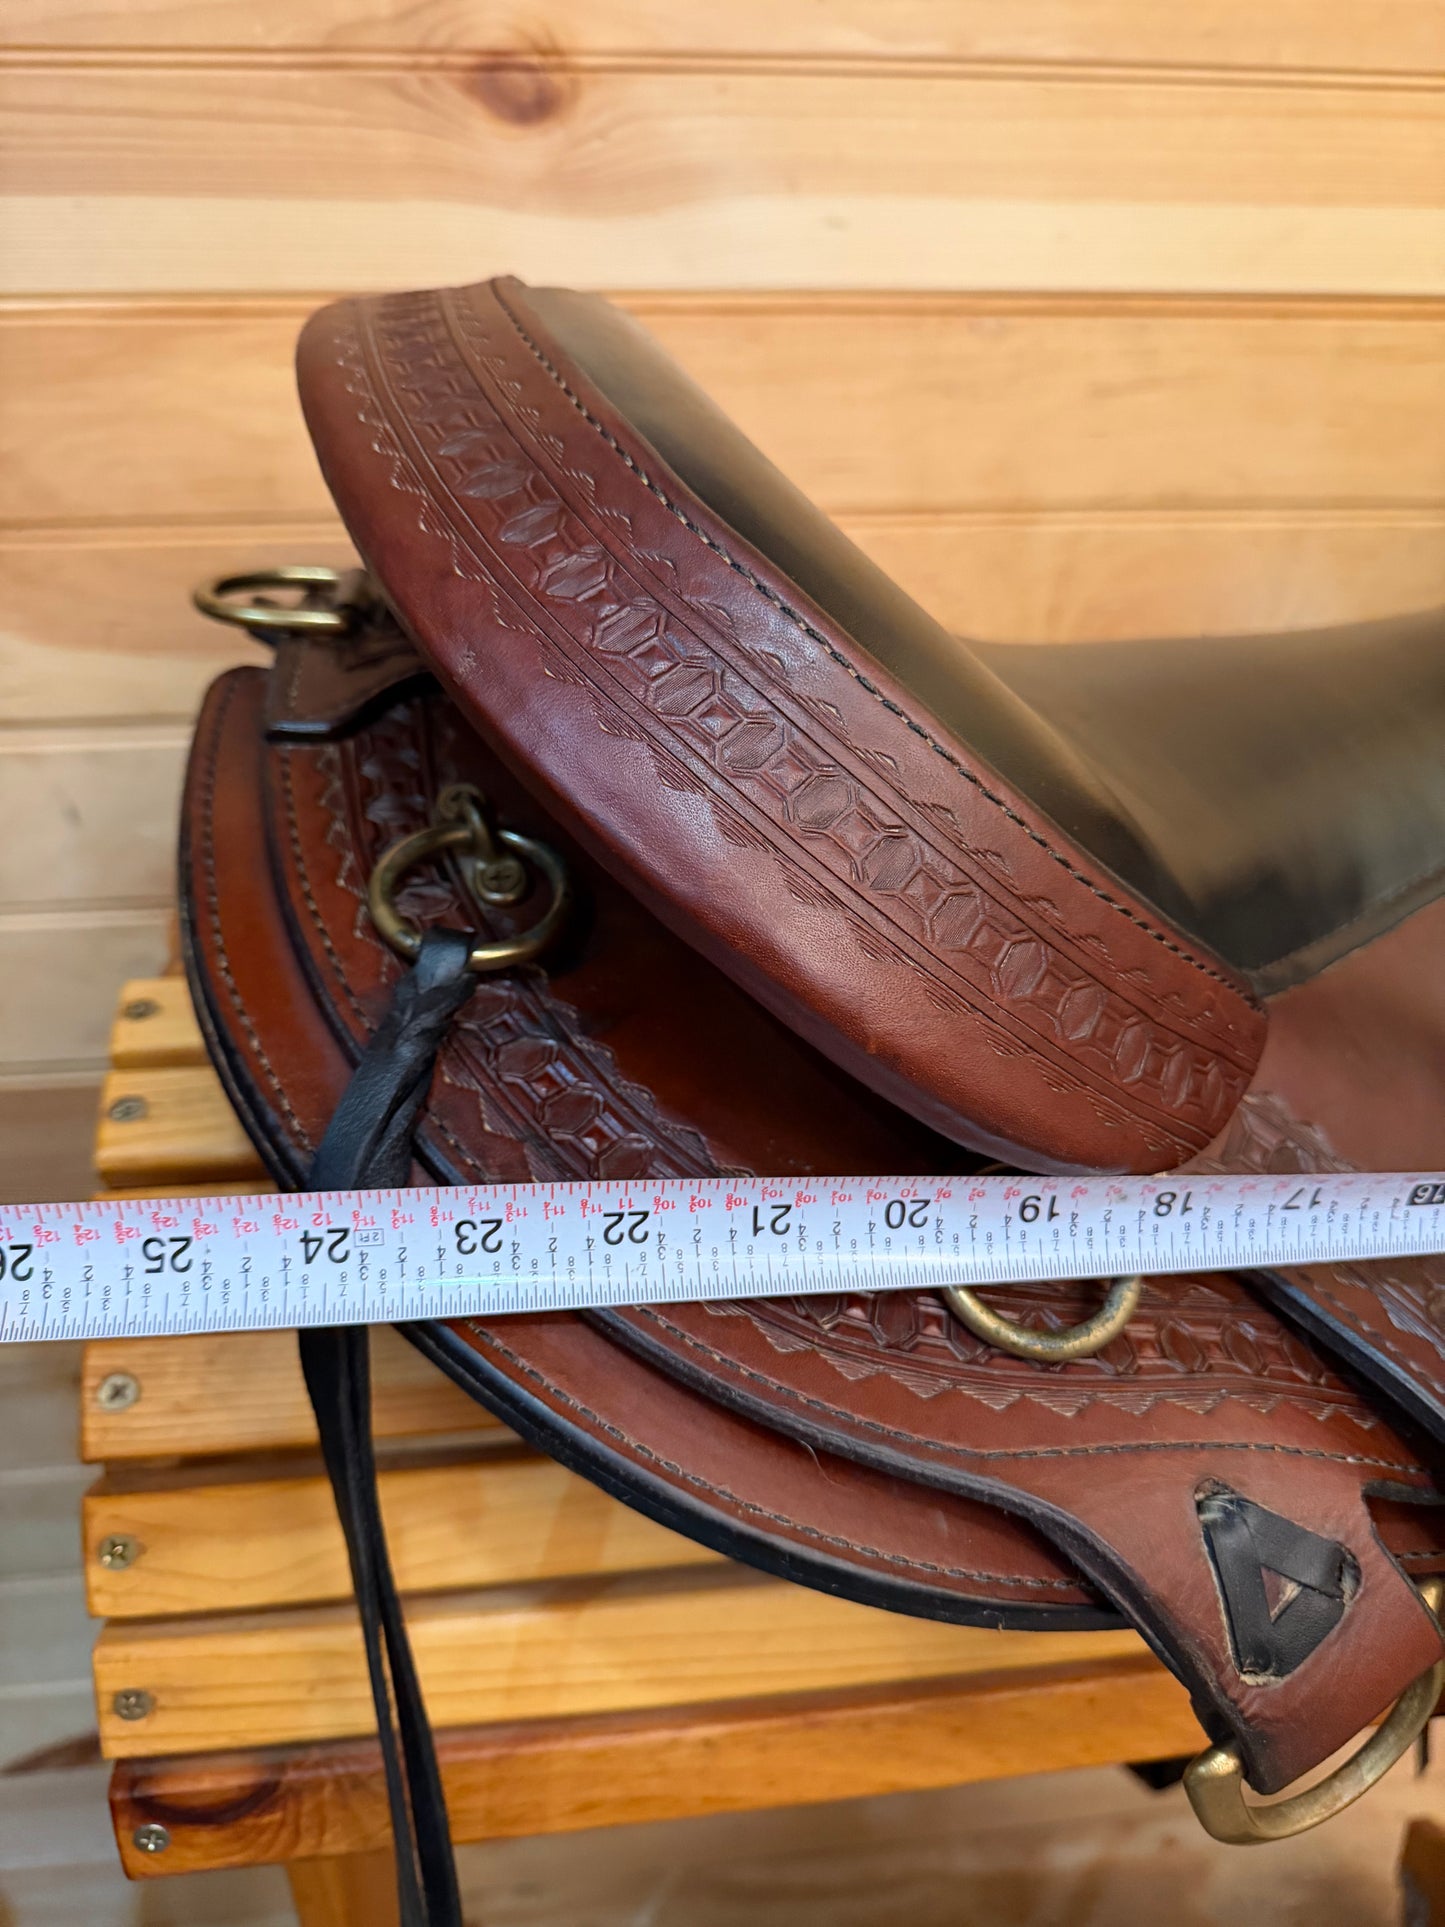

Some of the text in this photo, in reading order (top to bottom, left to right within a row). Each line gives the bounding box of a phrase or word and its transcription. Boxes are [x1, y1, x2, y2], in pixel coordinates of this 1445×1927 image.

[885, 1199, 930, 1229] 20
[1019, 1195, 1060, 1223] 19
[1153, 1192, 1192, 1217] 18
[1280, 1188, 1322, 1210] 17
[455, 1219, 502, 1255] 23
[603, 1210, 649, 1245] 22
[752, 1204, 792, 1237] 21
[0, 1244, 34, 1282] 2
[142, 1236, 193, 1273] 25
[300, 1228, 350, 1264] 24
